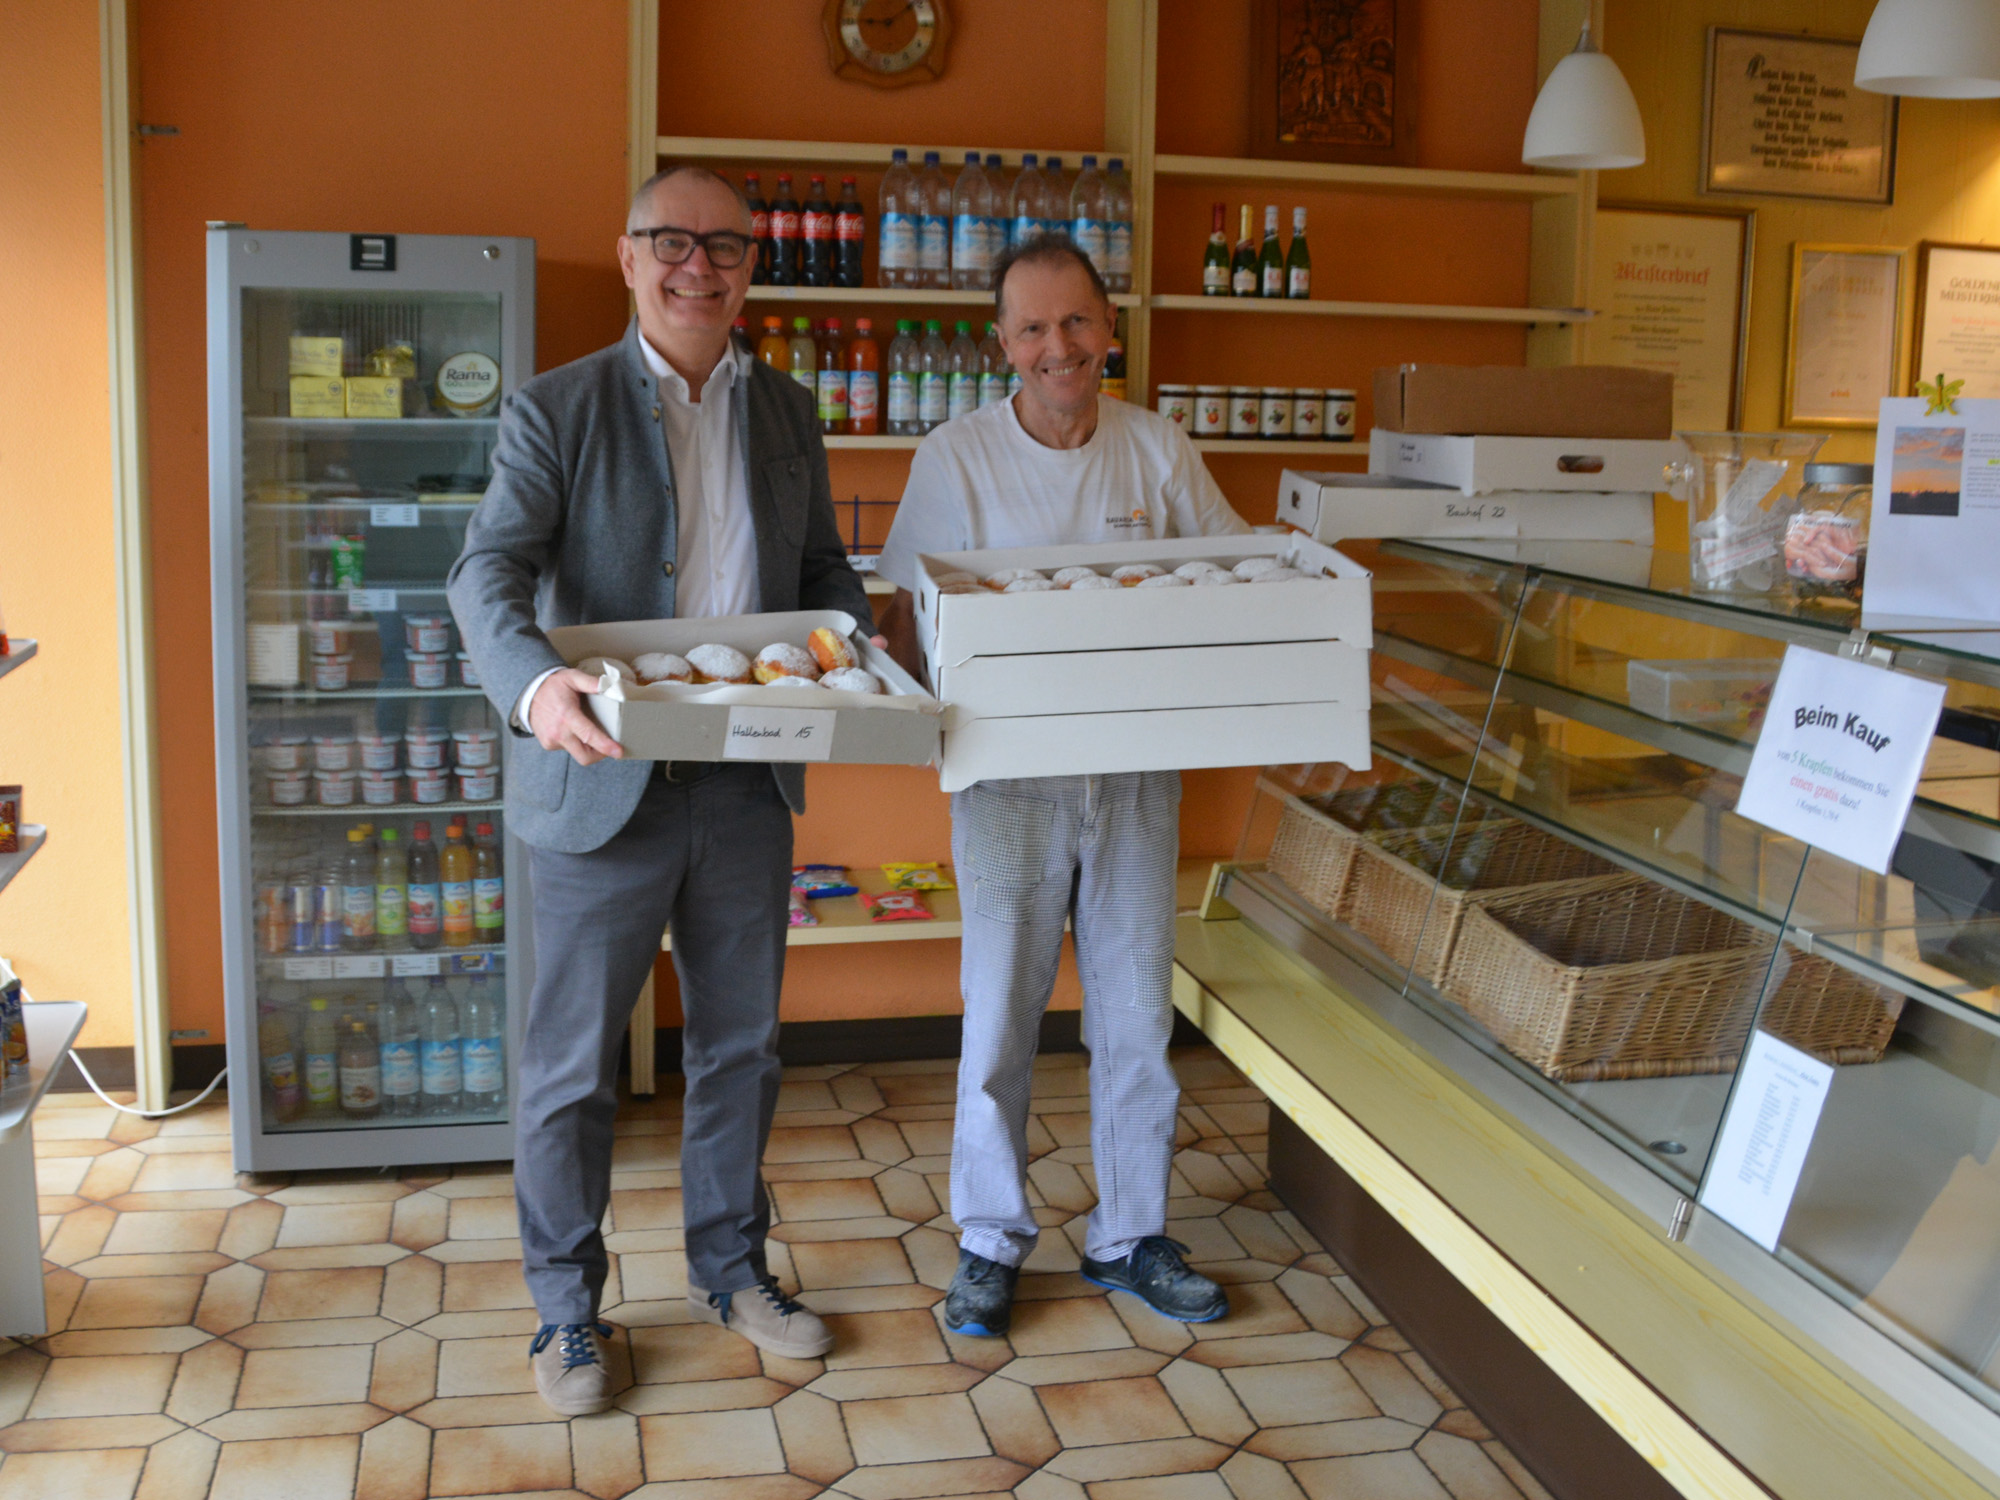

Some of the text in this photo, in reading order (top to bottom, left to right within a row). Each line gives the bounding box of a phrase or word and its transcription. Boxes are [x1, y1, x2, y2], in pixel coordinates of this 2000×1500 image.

[446, 368, 490, 381] Rama
[732, 724, 814, 739] Hallenbad 15
[1794, 704, 1891, 753] Beim Kauf
[1791, 750, 1799, 763] 5
[1798, 752, 1834, 777] Krapfen
[1875, 783, 1890, 798] Sie
[1790, 775, 1813, 792] einen
[1814, 785, 1839, 802] gratis
